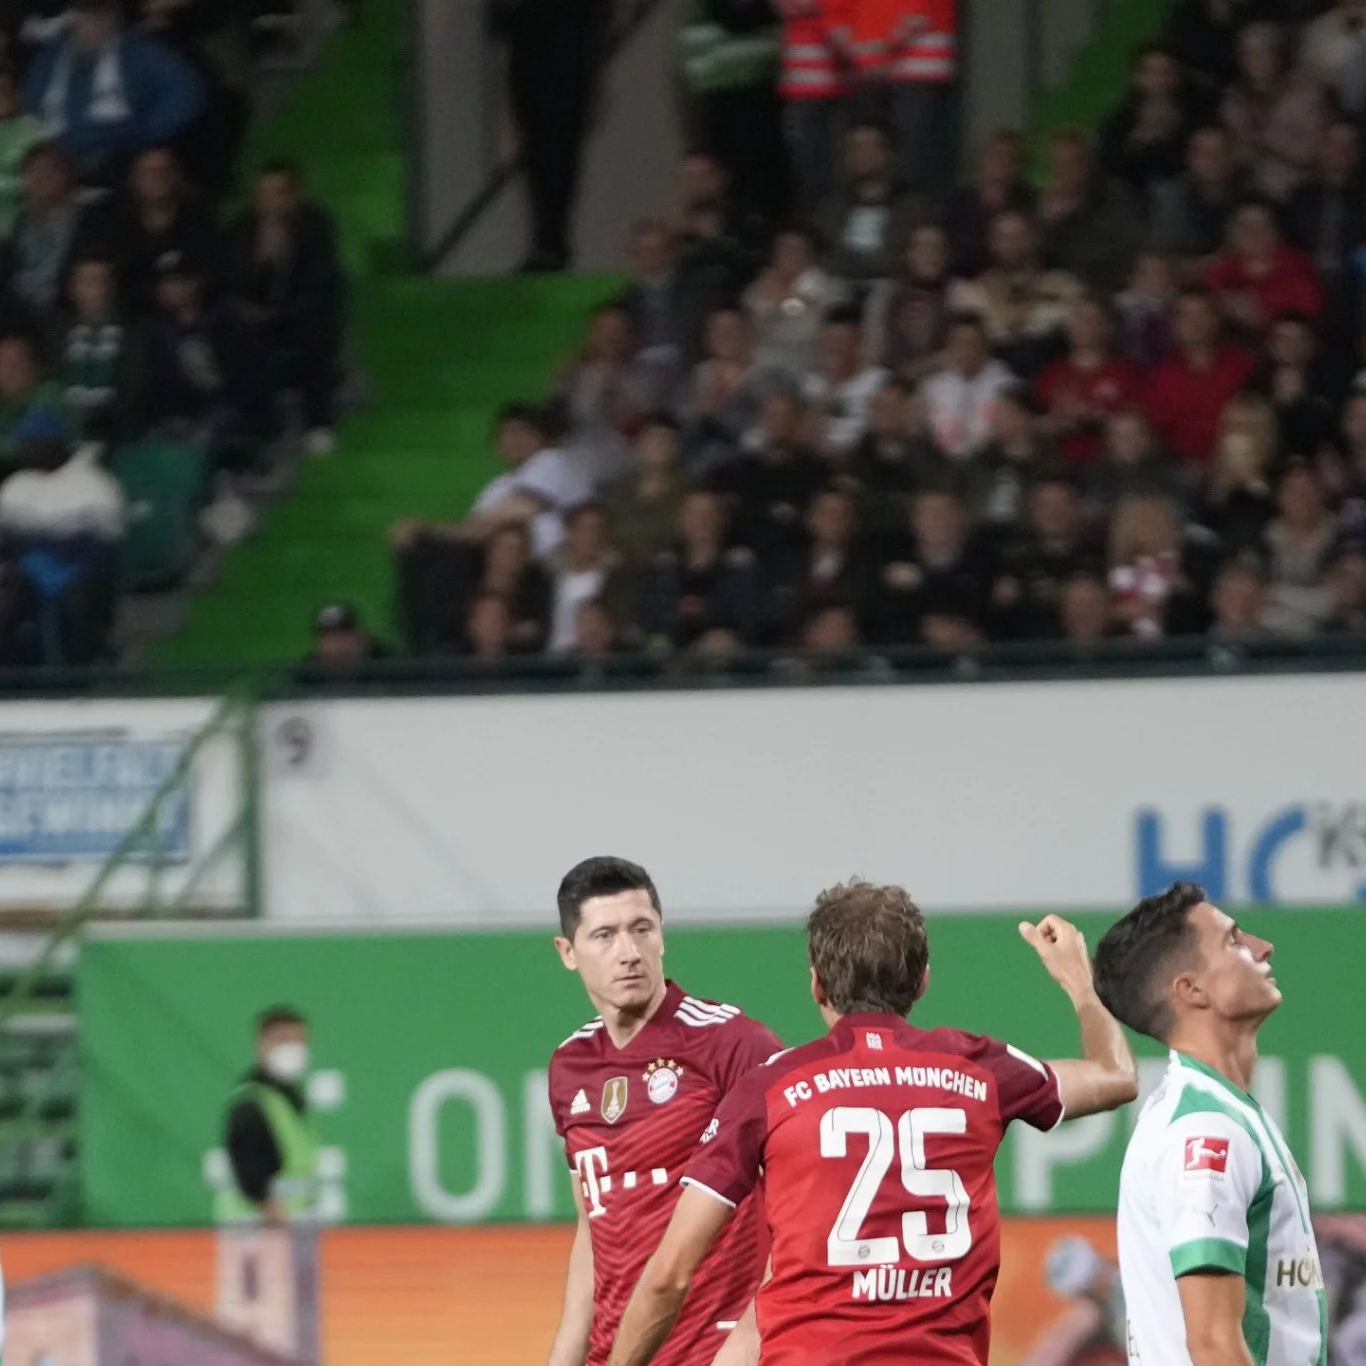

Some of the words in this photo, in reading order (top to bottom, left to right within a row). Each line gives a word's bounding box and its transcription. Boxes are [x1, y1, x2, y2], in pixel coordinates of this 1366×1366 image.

[783, 1081, 813, 1108] FC
[814, 1067, 892, 1094] BAYERN
[895, 1065, 988, 1103] MÜNCHEN
[819, 1106, 973, 1267] 25
[851, 1264, 953, 1301] MÜLLER
